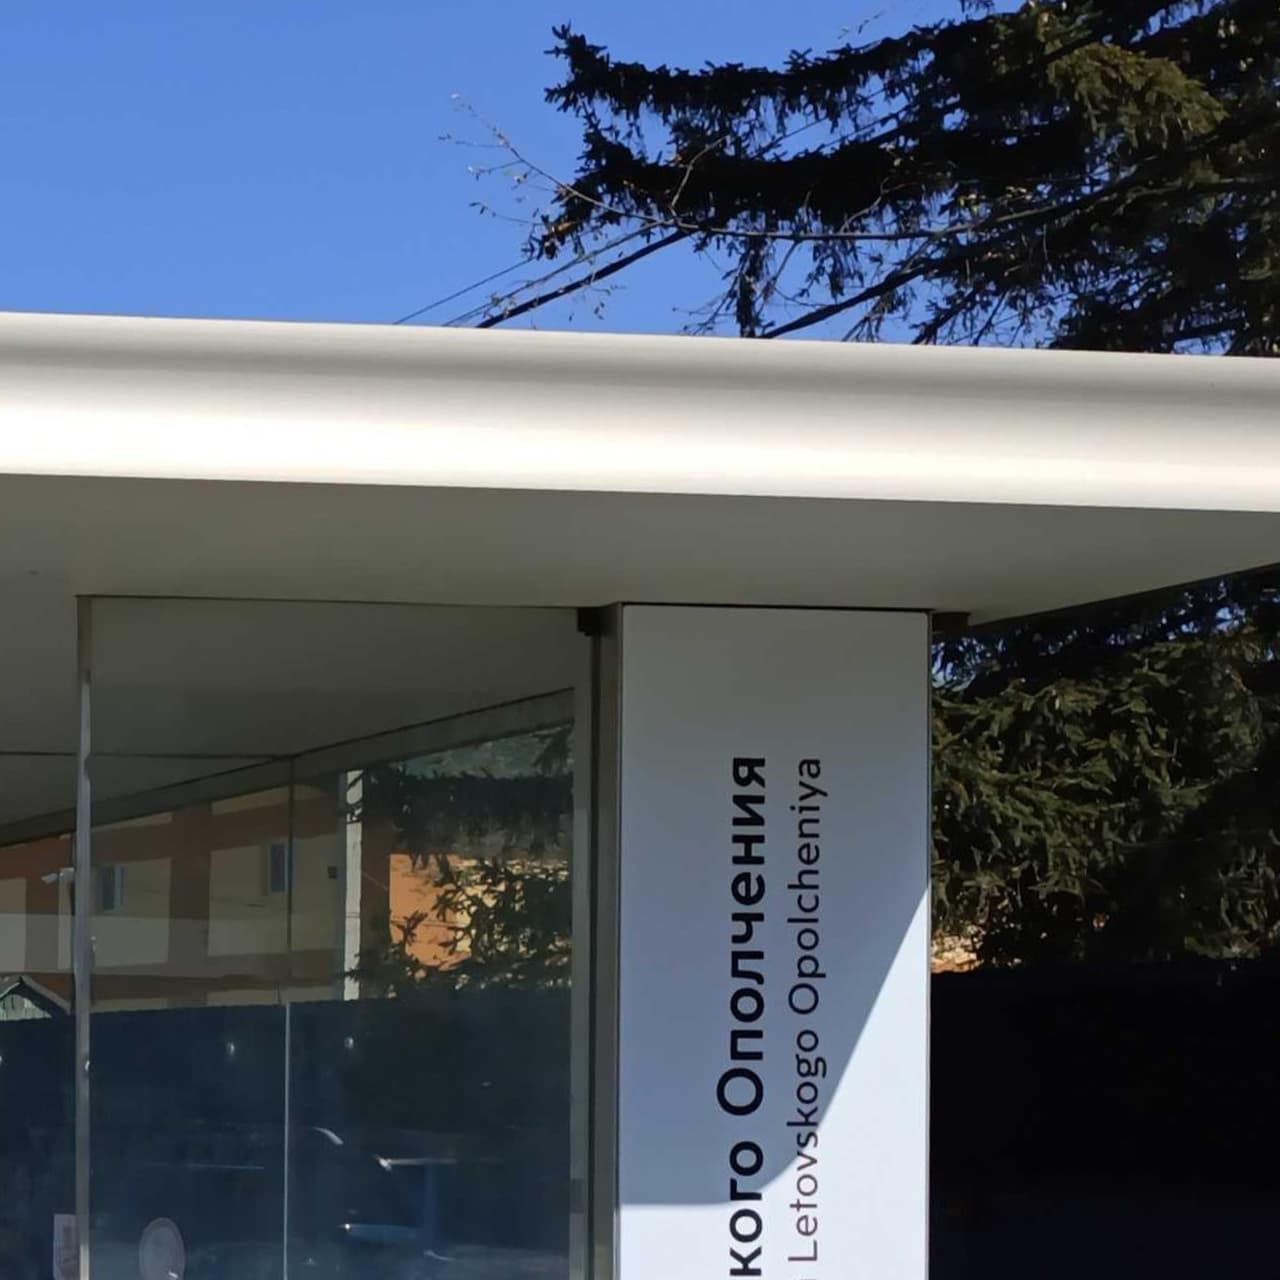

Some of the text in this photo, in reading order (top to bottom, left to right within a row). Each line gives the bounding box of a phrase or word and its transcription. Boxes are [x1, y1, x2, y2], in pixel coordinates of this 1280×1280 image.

[716, 756, 766, 1117] Ополчения
[787, 757, 828, 1015] Opolcheniya
[787, 1029, 827, 1262] Letovskogo
